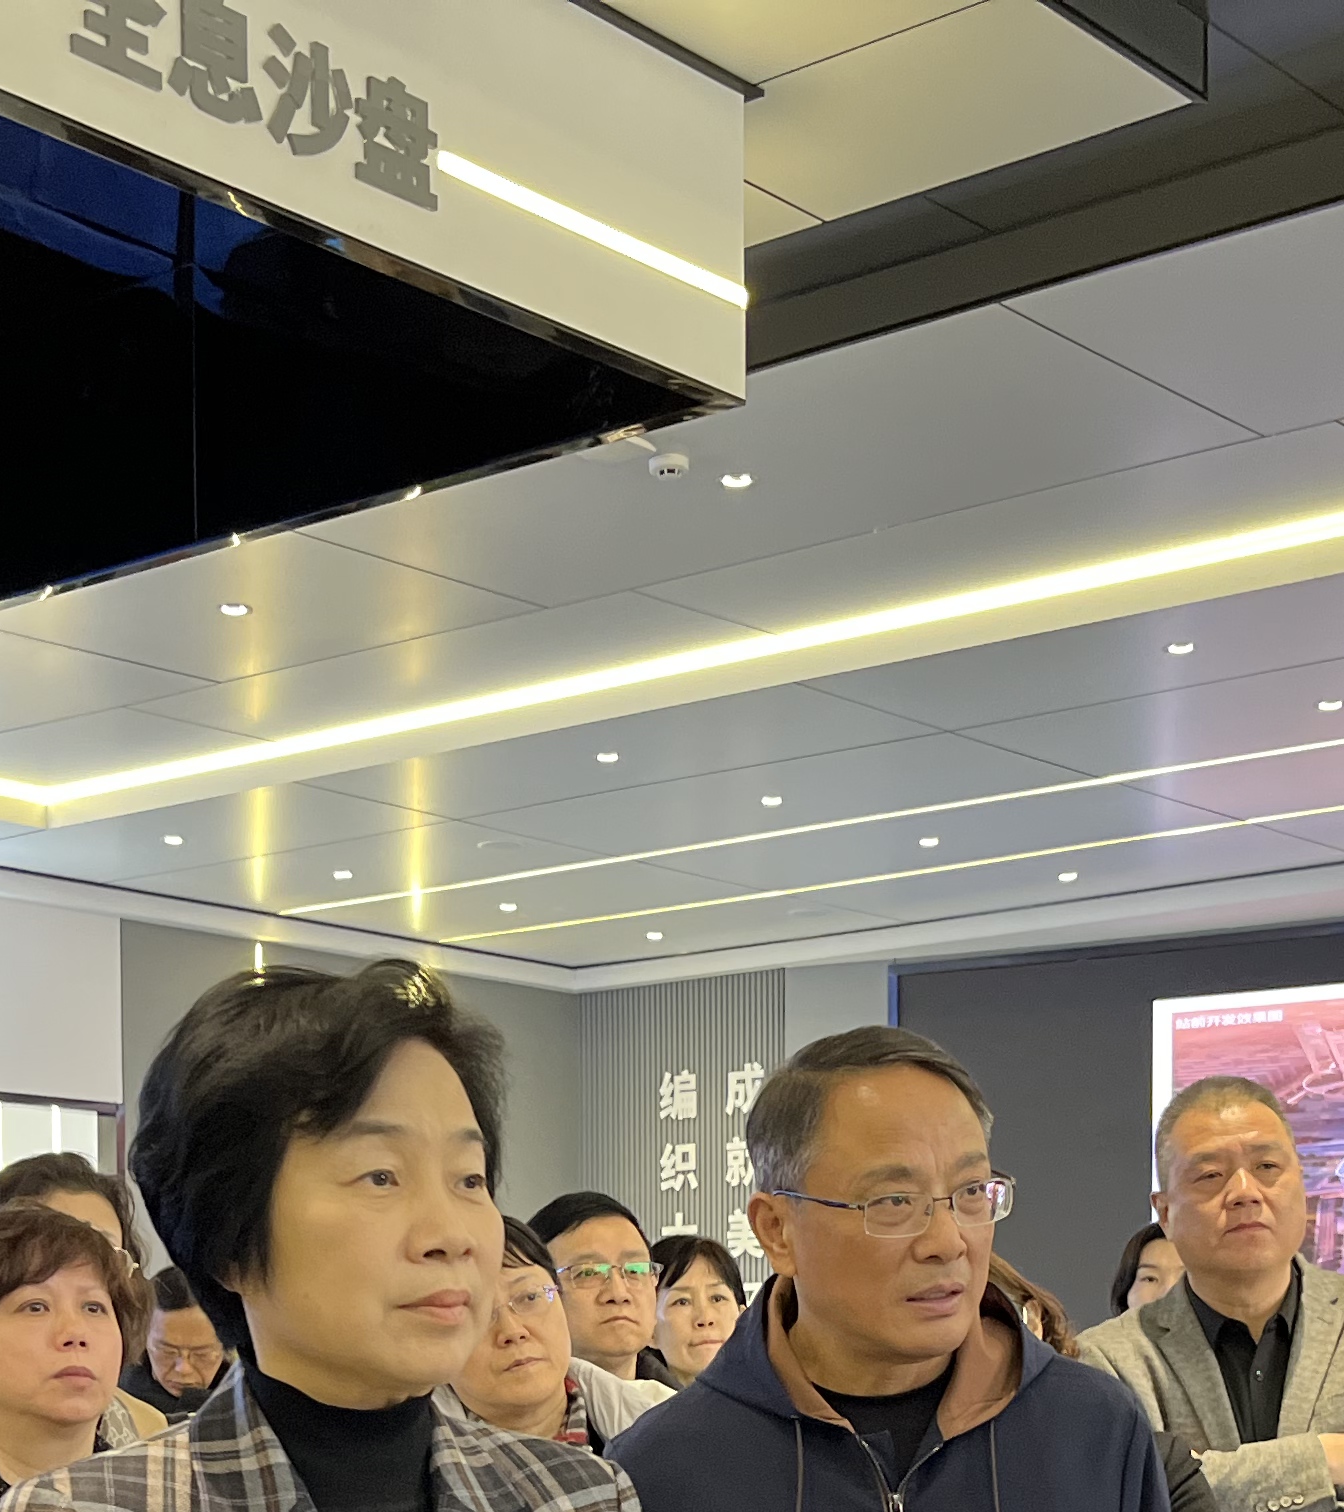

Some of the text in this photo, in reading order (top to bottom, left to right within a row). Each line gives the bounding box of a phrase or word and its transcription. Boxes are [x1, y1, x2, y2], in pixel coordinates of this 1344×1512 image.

[69, 0, 439, 212] 全息沙盘
[1175, 1009, 1283, 1030] 站前开发效果图
